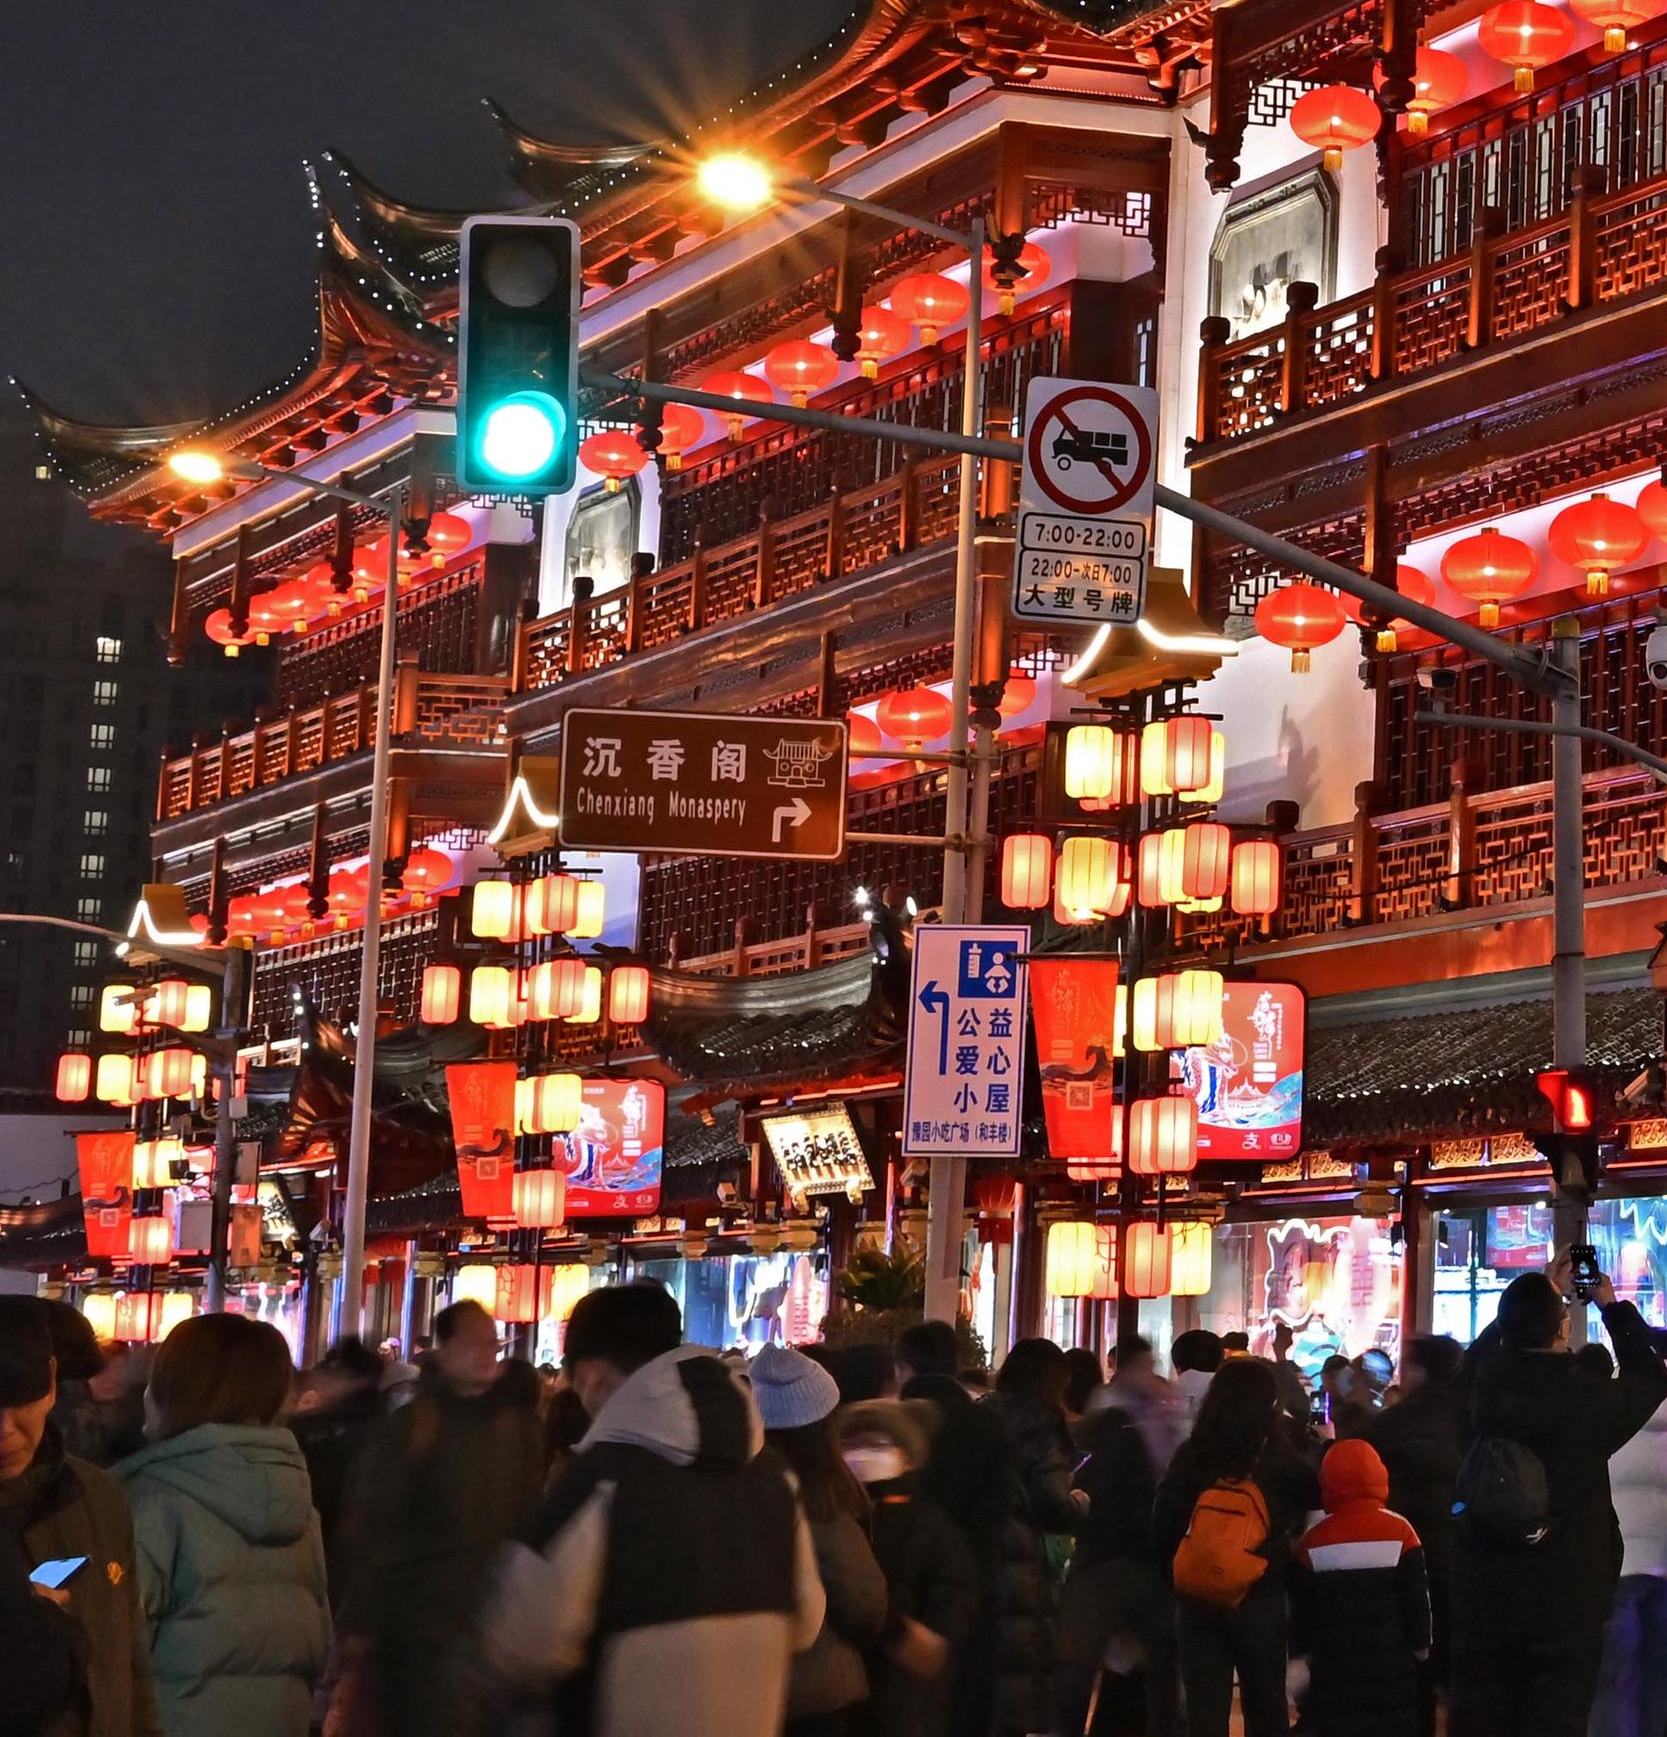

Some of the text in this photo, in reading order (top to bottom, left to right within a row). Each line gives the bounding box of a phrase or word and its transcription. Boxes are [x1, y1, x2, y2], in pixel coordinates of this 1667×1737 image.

[1034, 522, 1136, 550] 7:00-22:00
[1030, 557, 1132, 584] 22:00-次日7:00
[1023, 583, 1134, 614] 大型号牌
[581, 736, 748, 784] 沉香阁
[576, 786, 747, 827] Chenxiang Monaspery
[956, 1007, 1013, 1038] 公益
[955, 1044, 1012, 1076] 爱心
[953, 1082, 1010, 1113] 小屋
